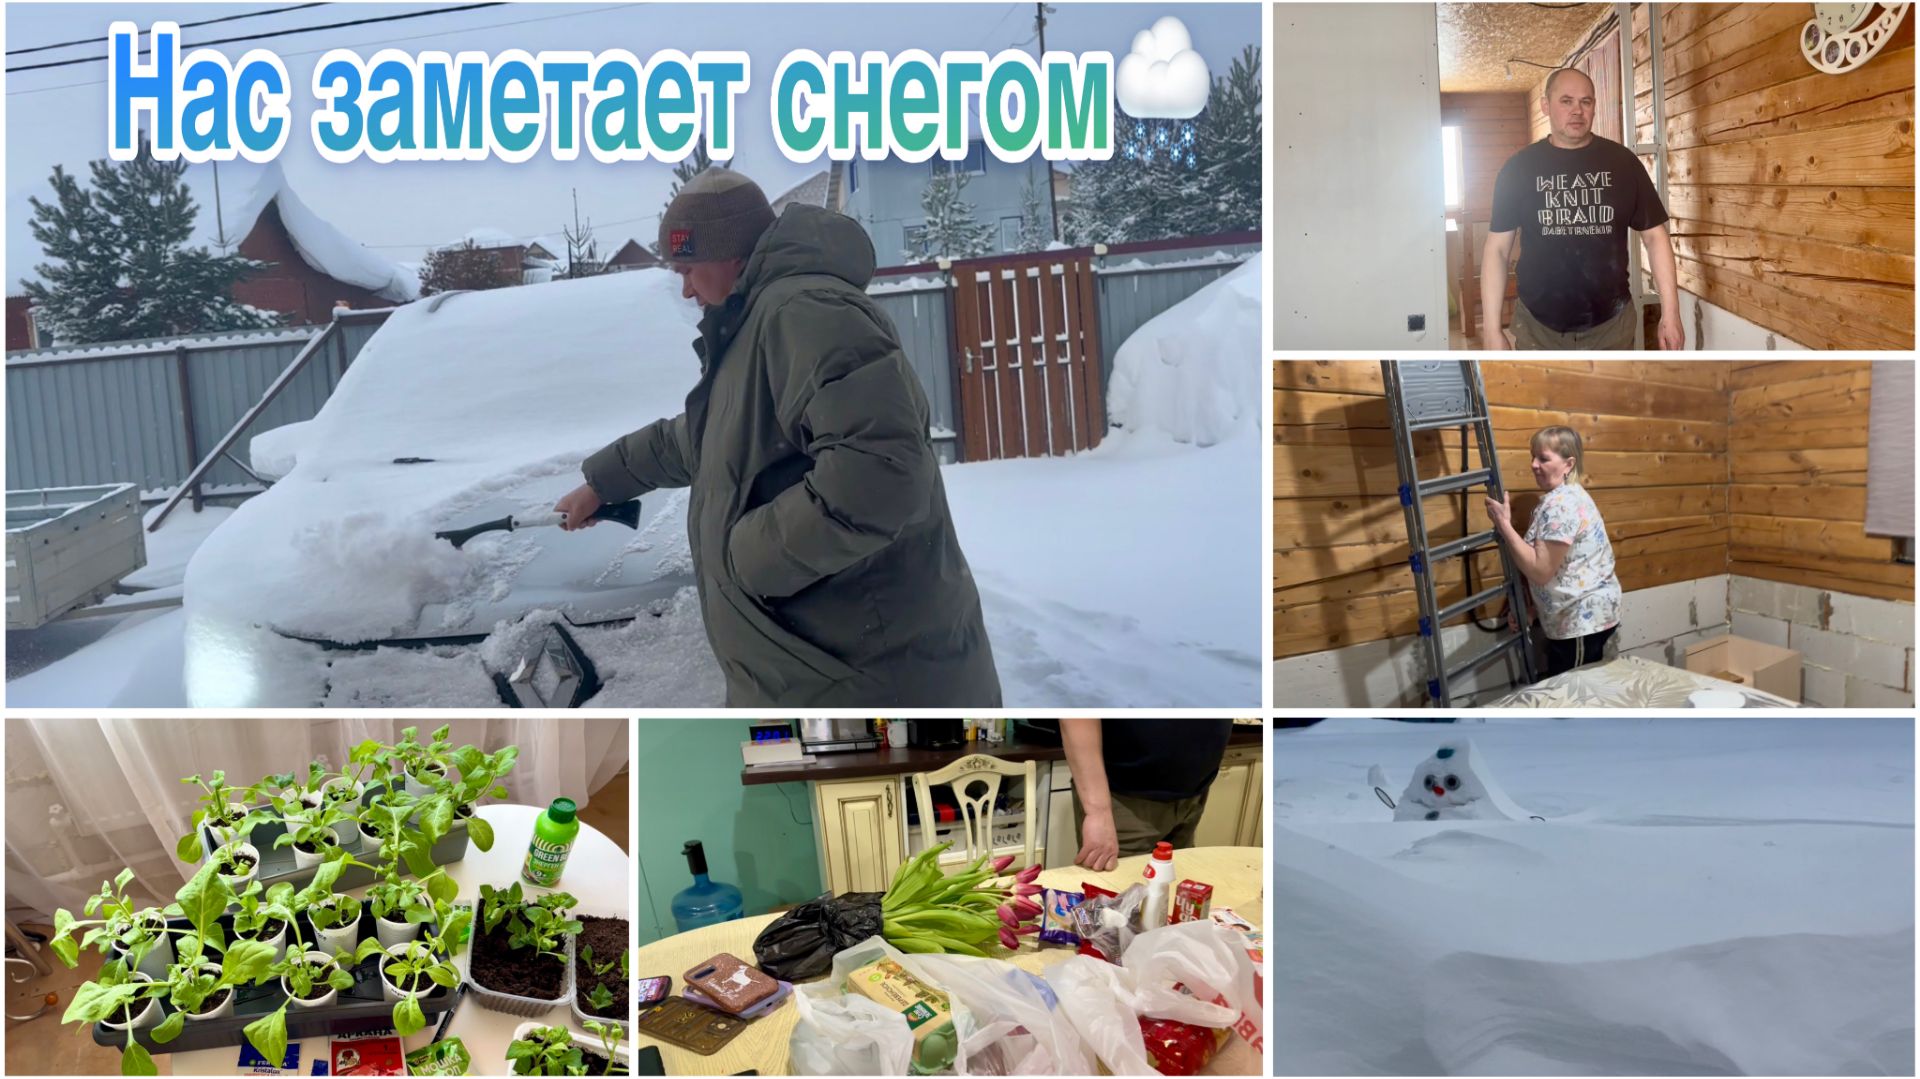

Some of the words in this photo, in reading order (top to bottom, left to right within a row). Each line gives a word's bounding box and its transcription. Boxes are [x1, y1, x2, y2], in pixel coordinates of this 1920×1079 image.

[1536, 171, 1613, 192] WEAVE
[1545, 187, 1604, 208] KNIT
[1537, 205, 1614, 226] BRAID
[672, 233, 689, 243] STAY
[673, 245, 692, 253] REAL
[533, 848, 560, 863] GREEN
[420, 1053, 462, 1075] МОШКА
